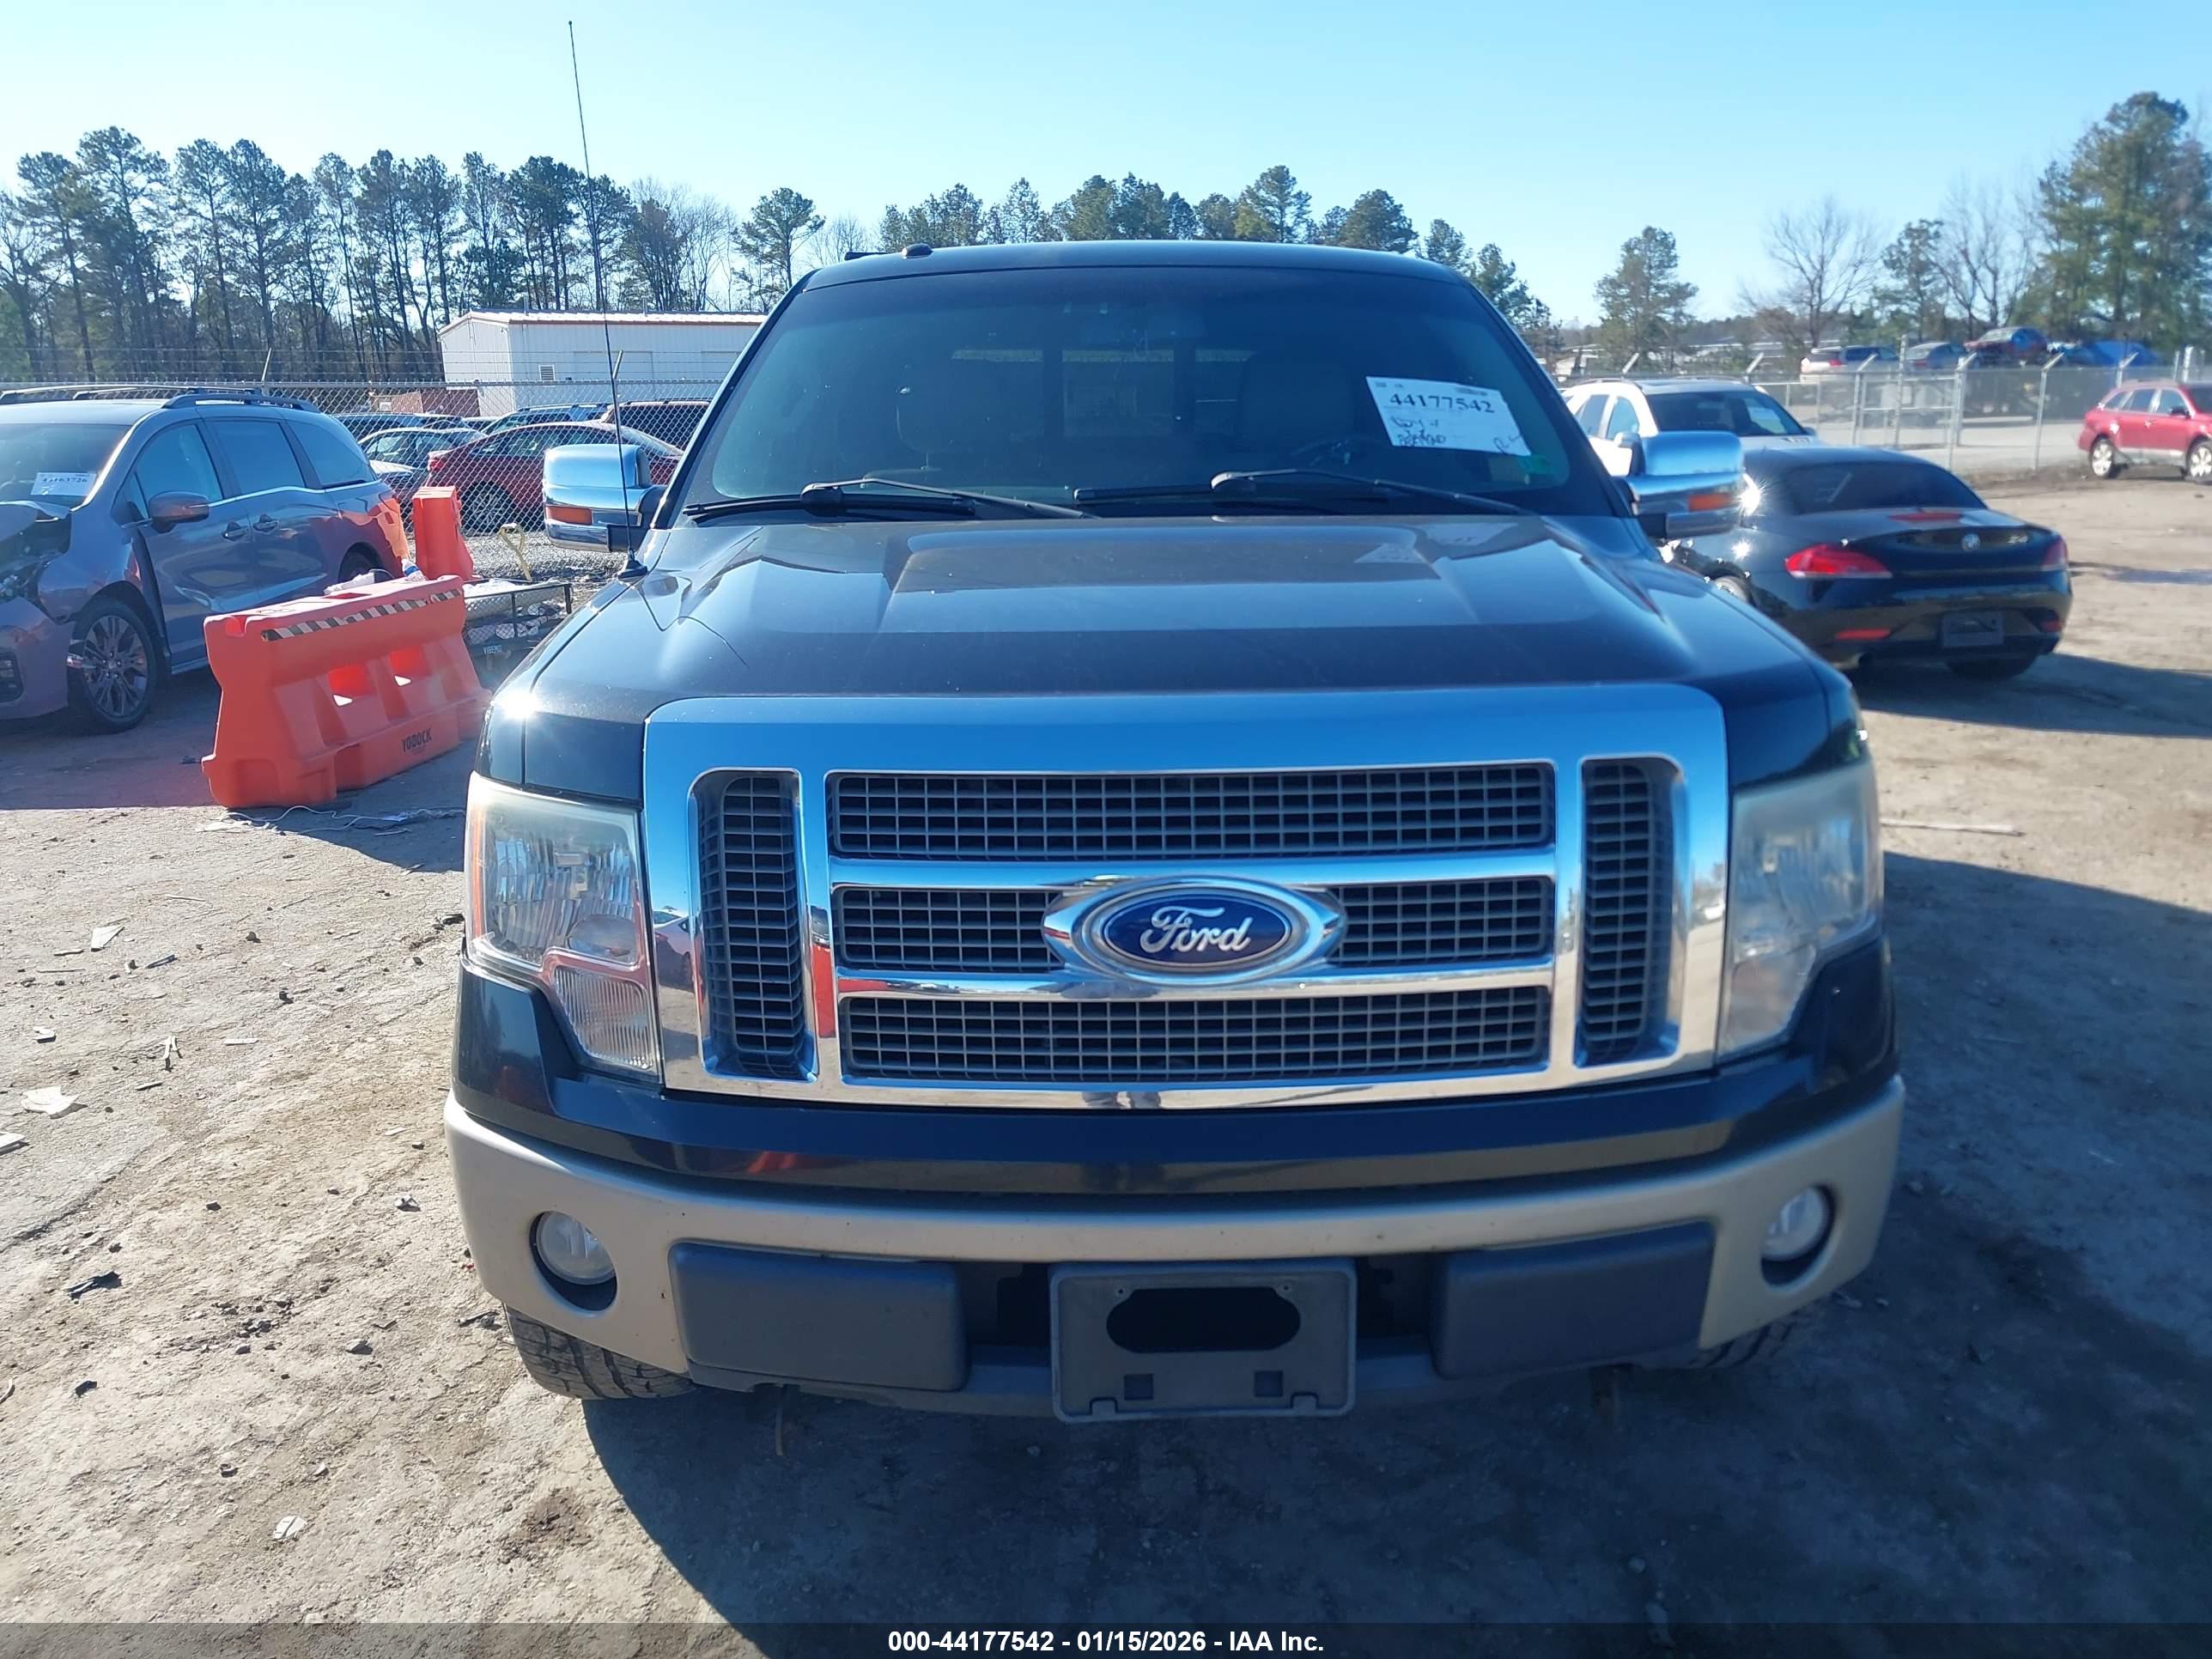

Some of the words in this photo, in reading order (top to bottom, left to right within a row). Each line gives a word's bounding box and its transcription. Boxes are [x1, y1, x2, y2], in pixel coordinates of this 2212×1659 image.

[1390, 393, 1495, 413] 44177542
[401, 728, 432, 752] YODOCK
[1140, 905, 1254, 954] Ford
